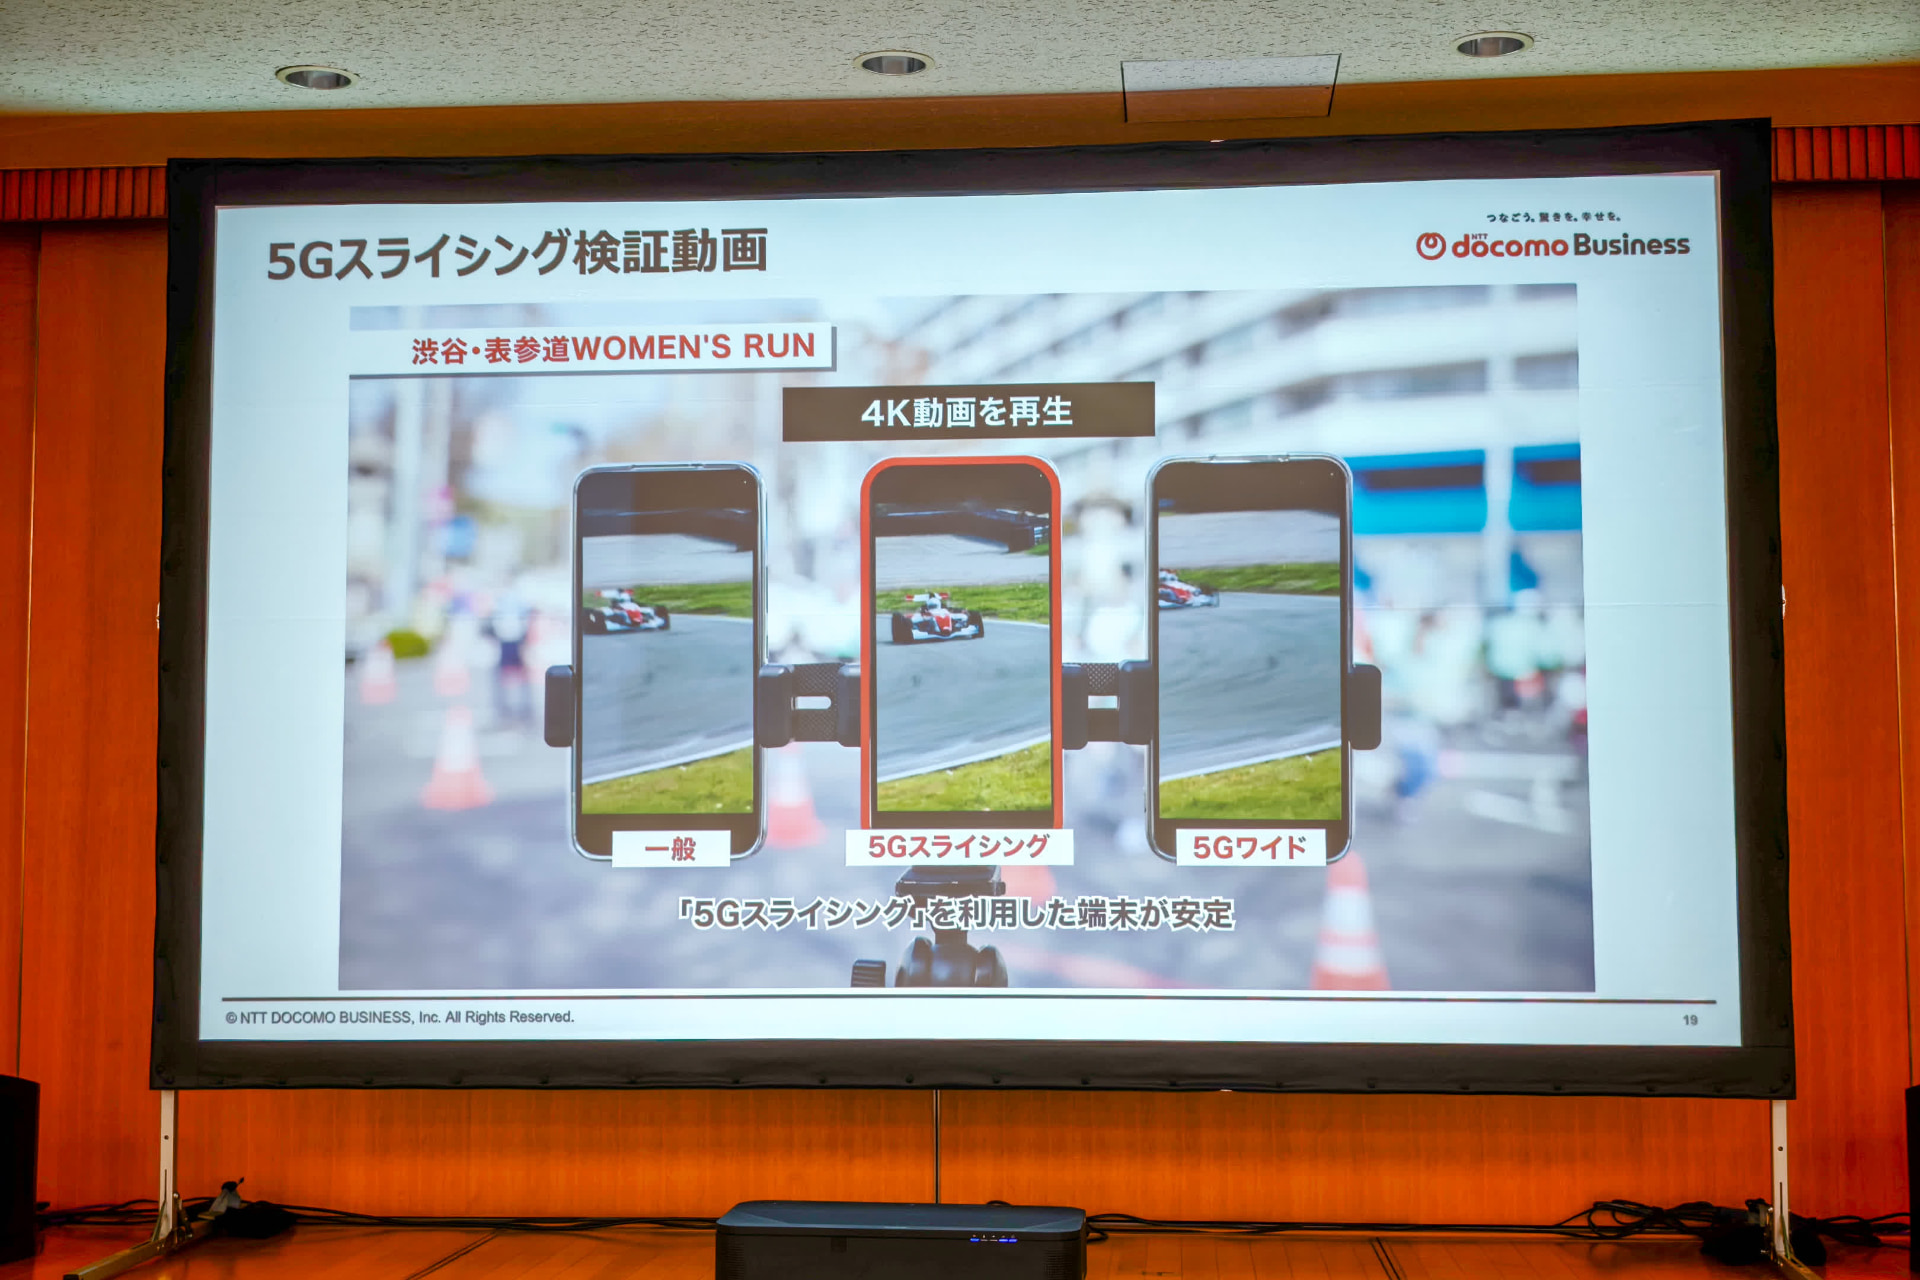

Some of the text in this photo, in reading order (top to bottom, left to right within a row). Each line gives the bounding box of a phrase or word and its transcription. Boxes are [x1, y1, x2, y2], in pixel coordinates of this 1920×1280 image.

[1451, 232, 1691, 258] docomo Business
[1471, 232, 1489, 240] NTT
[267, 227, 769, 281] 5Gスライシング検証動画
[743, 332, 816, 358] RUN
[861, 395, 1073, 428] 4K動画を再生
[644, 836, 697, 862] 一般
[868, 833, 1051, 859] 5Gスライシング
[1193, 835, 1307, 860] 5Gワイド
[679, 896, 1235, 931] 「5Gスライシング」を利用した端末が安定
[240, 1011, 269, 1025] NTT
[271, 1011, 337, 1025] DOCOMO
[339, 1011, 415, 1026] BUSINESS,
[418, 1011, 442, 1025] Inc.
[445, 1011, 462, 1024] All
[465, 1011, 506, 1027] Rights
[509, 1011, 575, 1025] Reserved.
[1683, 1014, 1699, 1026] 19
